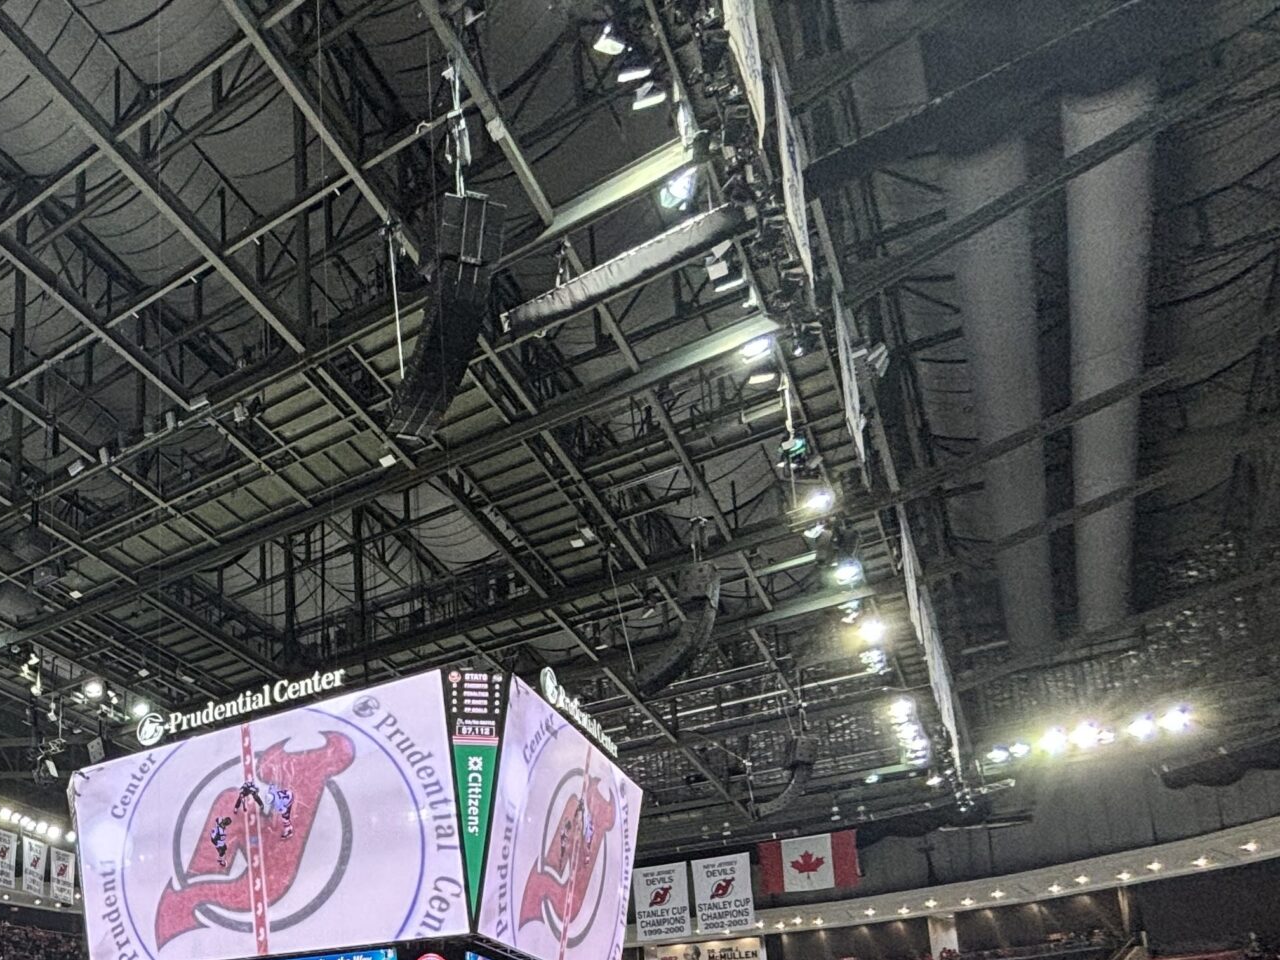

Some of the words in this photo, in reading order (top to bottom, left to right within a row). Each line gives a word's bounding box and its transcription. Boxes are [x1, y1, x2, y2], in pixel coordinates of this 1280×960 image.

[169, 684, 271, 734] Prudential
[273, 668, 345, 703] Center
[111, 753, 156, 820] Center
[373, 713, 459, 852] Prudential
[468, 773, 482, 834] Citizens
[706, 867, 736, 878] DEVILS
[646, 876, 674, 886] DEVILS
[698, 900, 733, 912] STANLEY
[734, 898, 751, 908] CUP
[638, 908, 671, 920] STANLEY
[672, 906, 688, 915] CUP
[701, 908, 750, 922] CHAMPIONS
[640, 916, 686, 929] CHAMPIONS
[704, 919, 749, 930] 2002-2003
